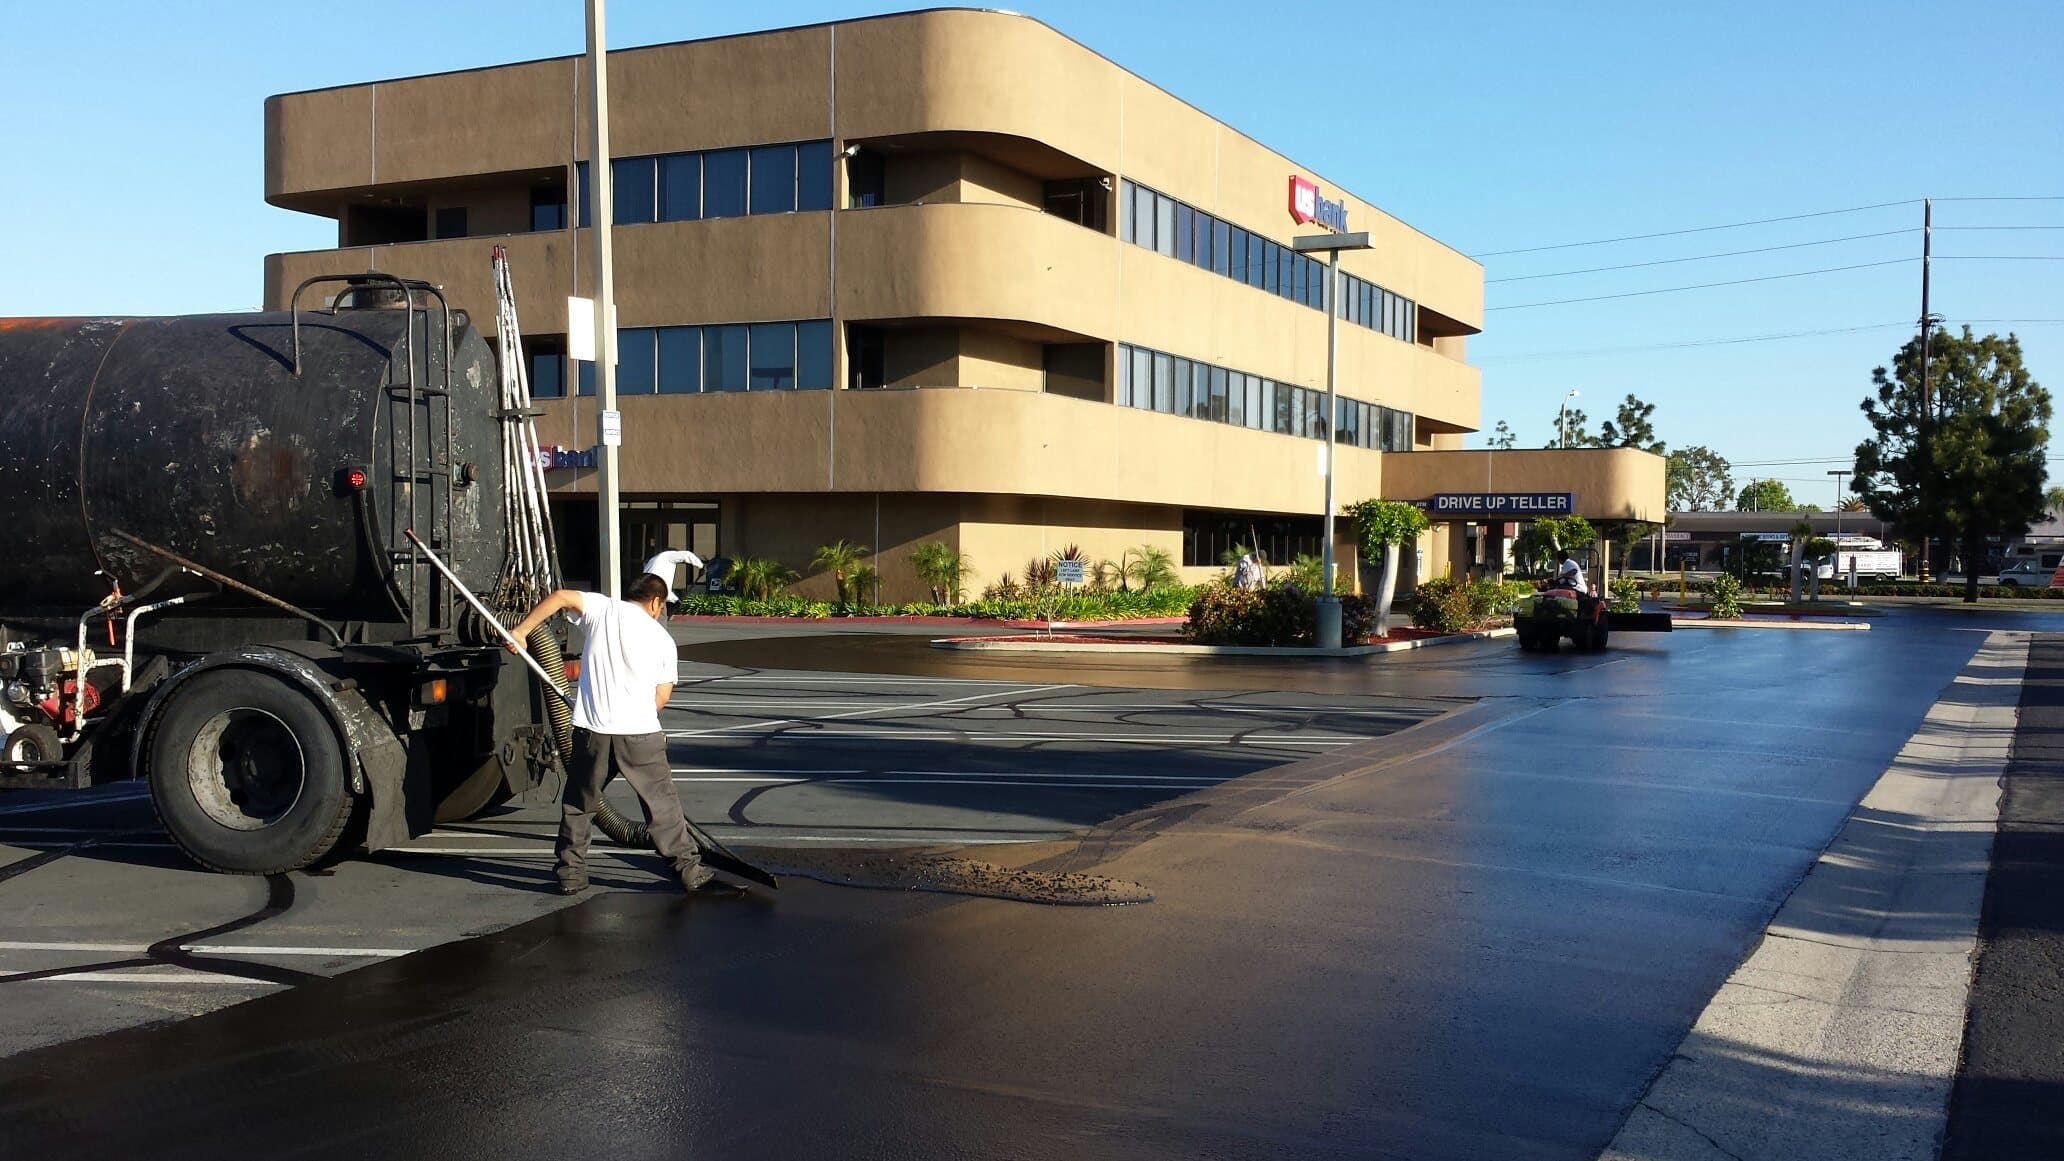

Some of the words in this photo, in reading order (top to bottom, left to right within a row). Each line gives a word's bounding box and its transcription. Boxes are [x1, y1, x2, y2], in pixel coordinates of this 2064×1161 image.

[1295, 184, 1315, 218] US
[1315, 186, 1348, 233] bank
[1438, 496, 1482, 509] DRIVE
[1486, 496, 1505, 509] UP
[1510, 496, 1567, 509] TELLER
